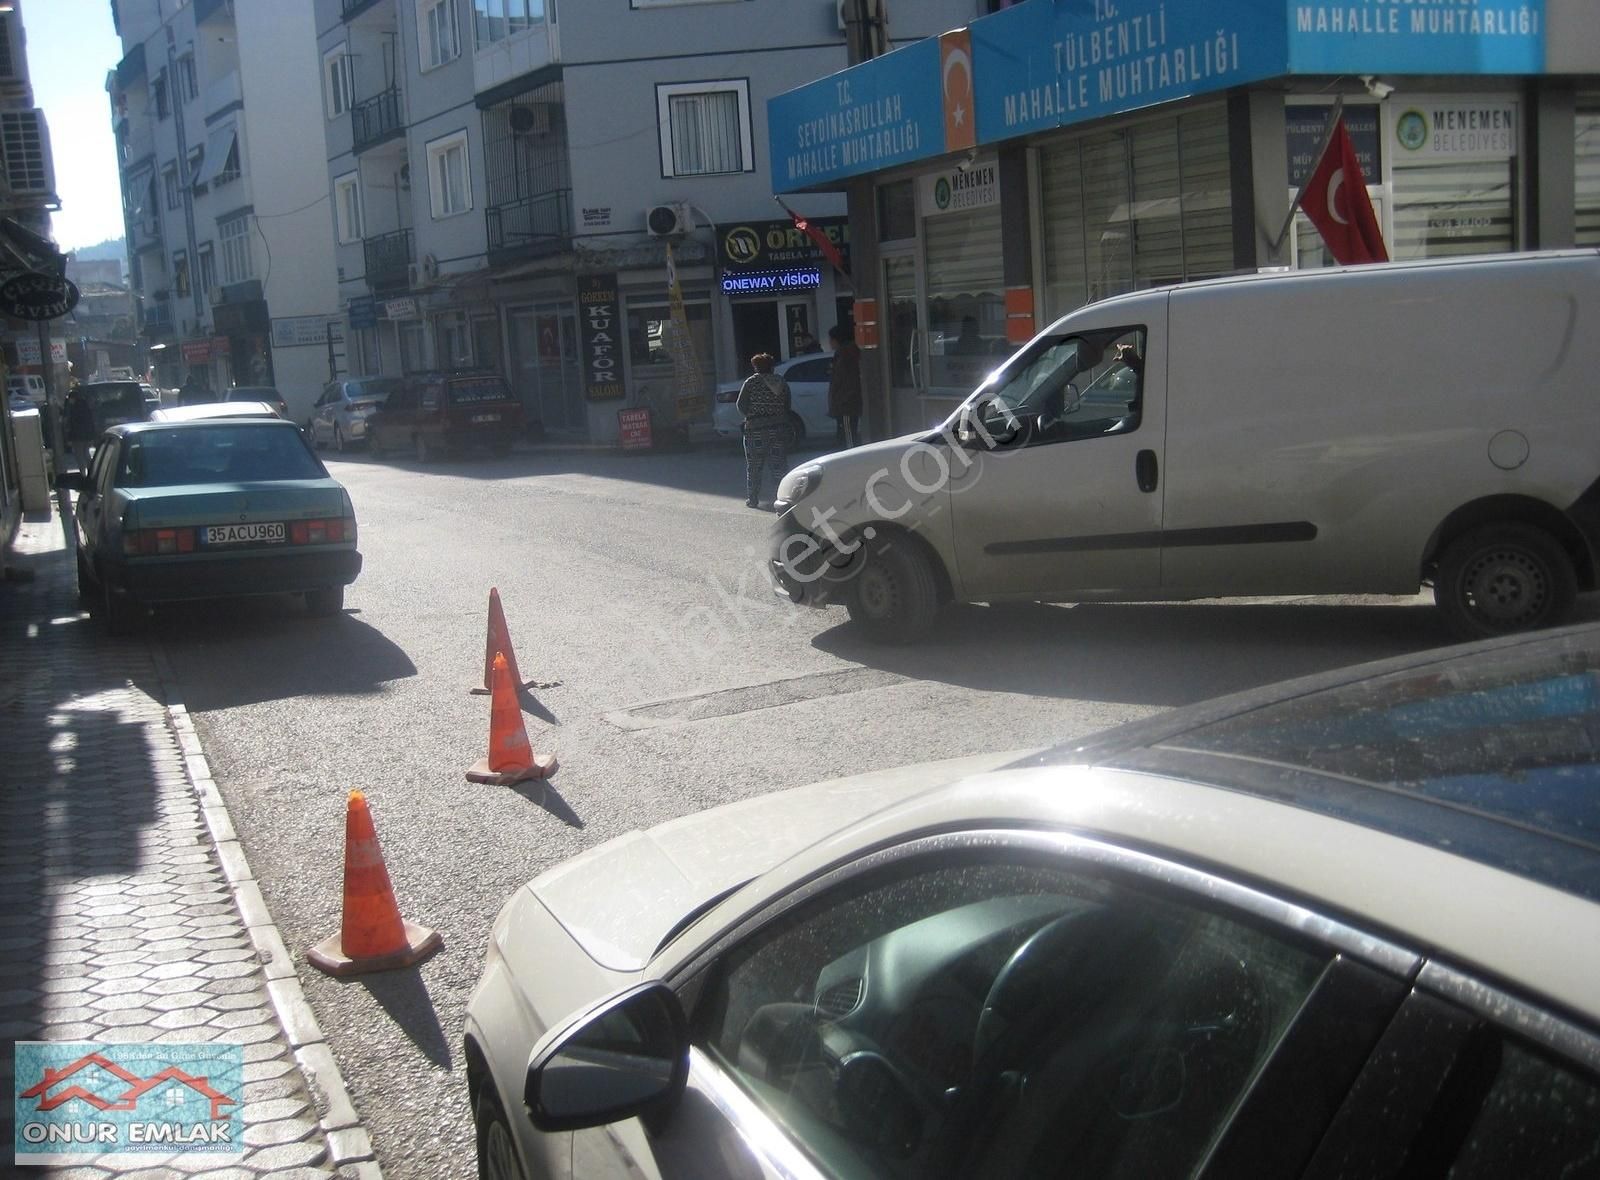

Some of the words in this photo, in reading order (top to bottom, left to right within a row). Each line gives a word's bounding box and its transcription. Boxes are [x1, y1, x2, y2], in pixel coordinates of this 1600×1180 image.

[1053, 4, 1166, 75] TÜLBENTLİ
[1297, 7, 1399, 34] MAHALLE
[1411, 6, 1539, 35] MUHTARLIĞI
[1004, 75, 1089, 127] MAHALLE
[1099, 29, 1239, 102] MUHTARLIĞI
[1433, 110, 1512, 132] MENEMEN
[787, 145, 838, 181] MAHALLE
[842, 119, 920, 168] MUHTARLIĞI
[952, 166, 995, 191] MENEMEN
[723, 276, 777, 291] ONEWAY
[587, 305, 617, 383] KUAFÖR
